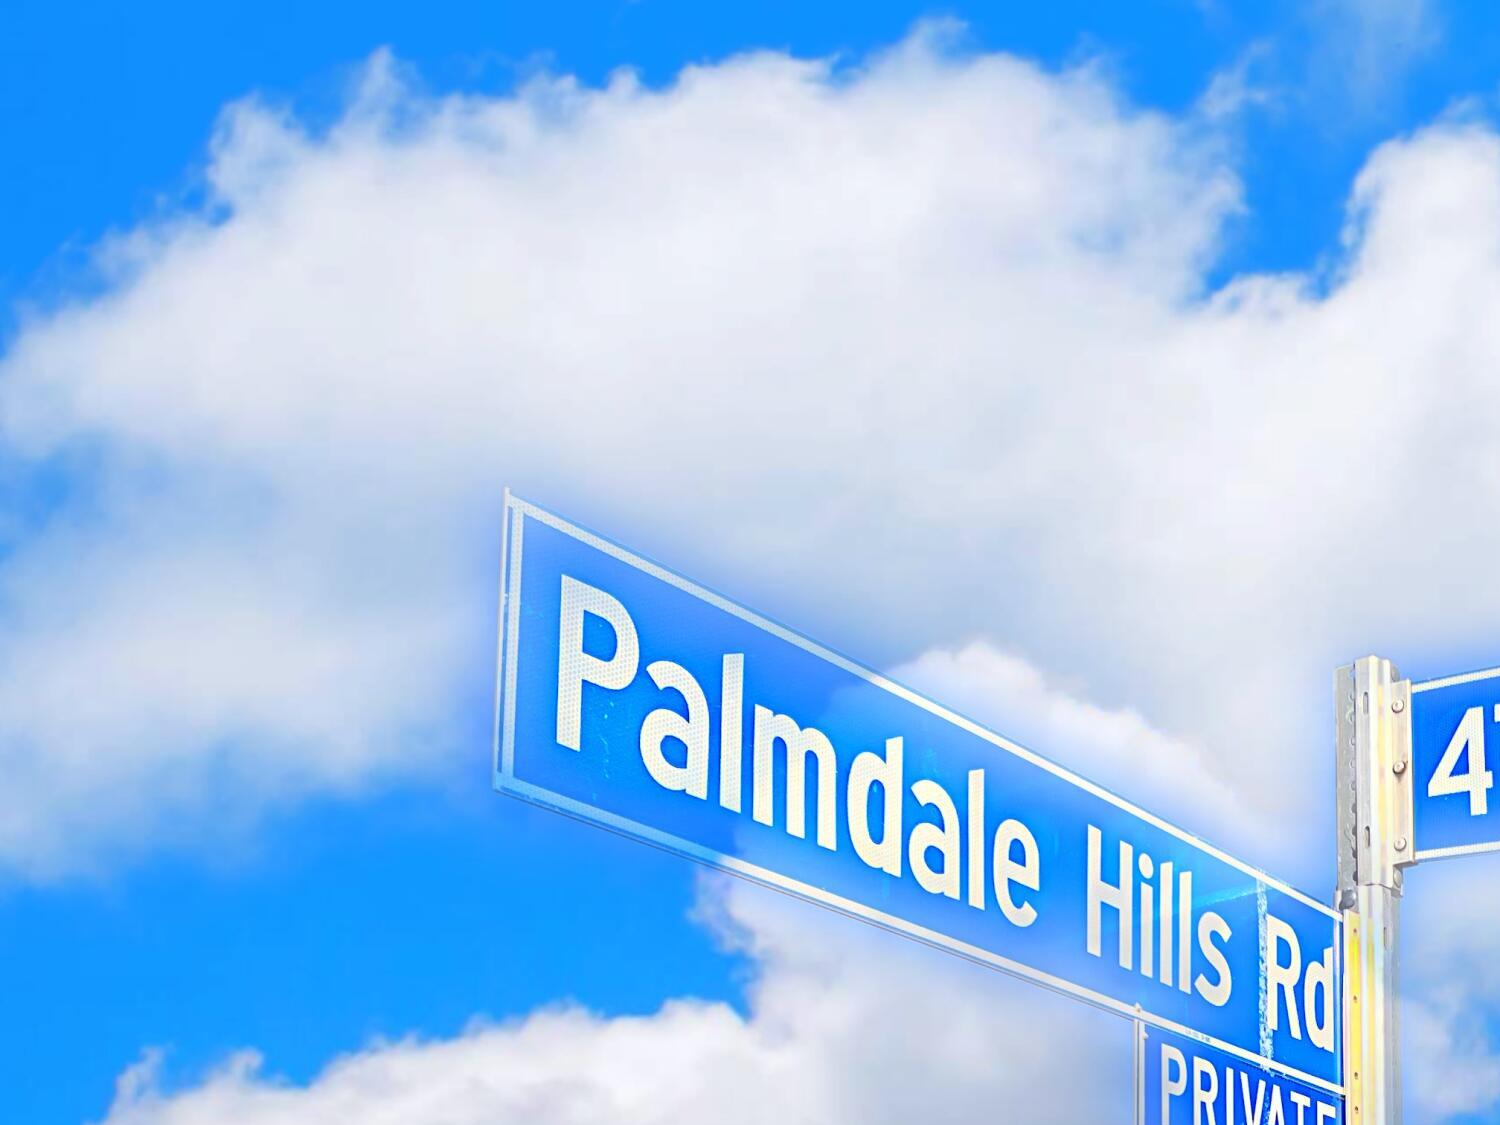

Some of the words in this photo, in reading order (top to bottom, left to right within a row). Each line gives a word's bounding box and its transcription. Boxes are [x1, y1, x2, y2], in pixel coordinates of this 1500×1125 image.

[555, 574, 1041, 928] Palmdale
[1086, 824, 1233, 1007] Hills
[1265, 913, 1335, 1053] Rd
